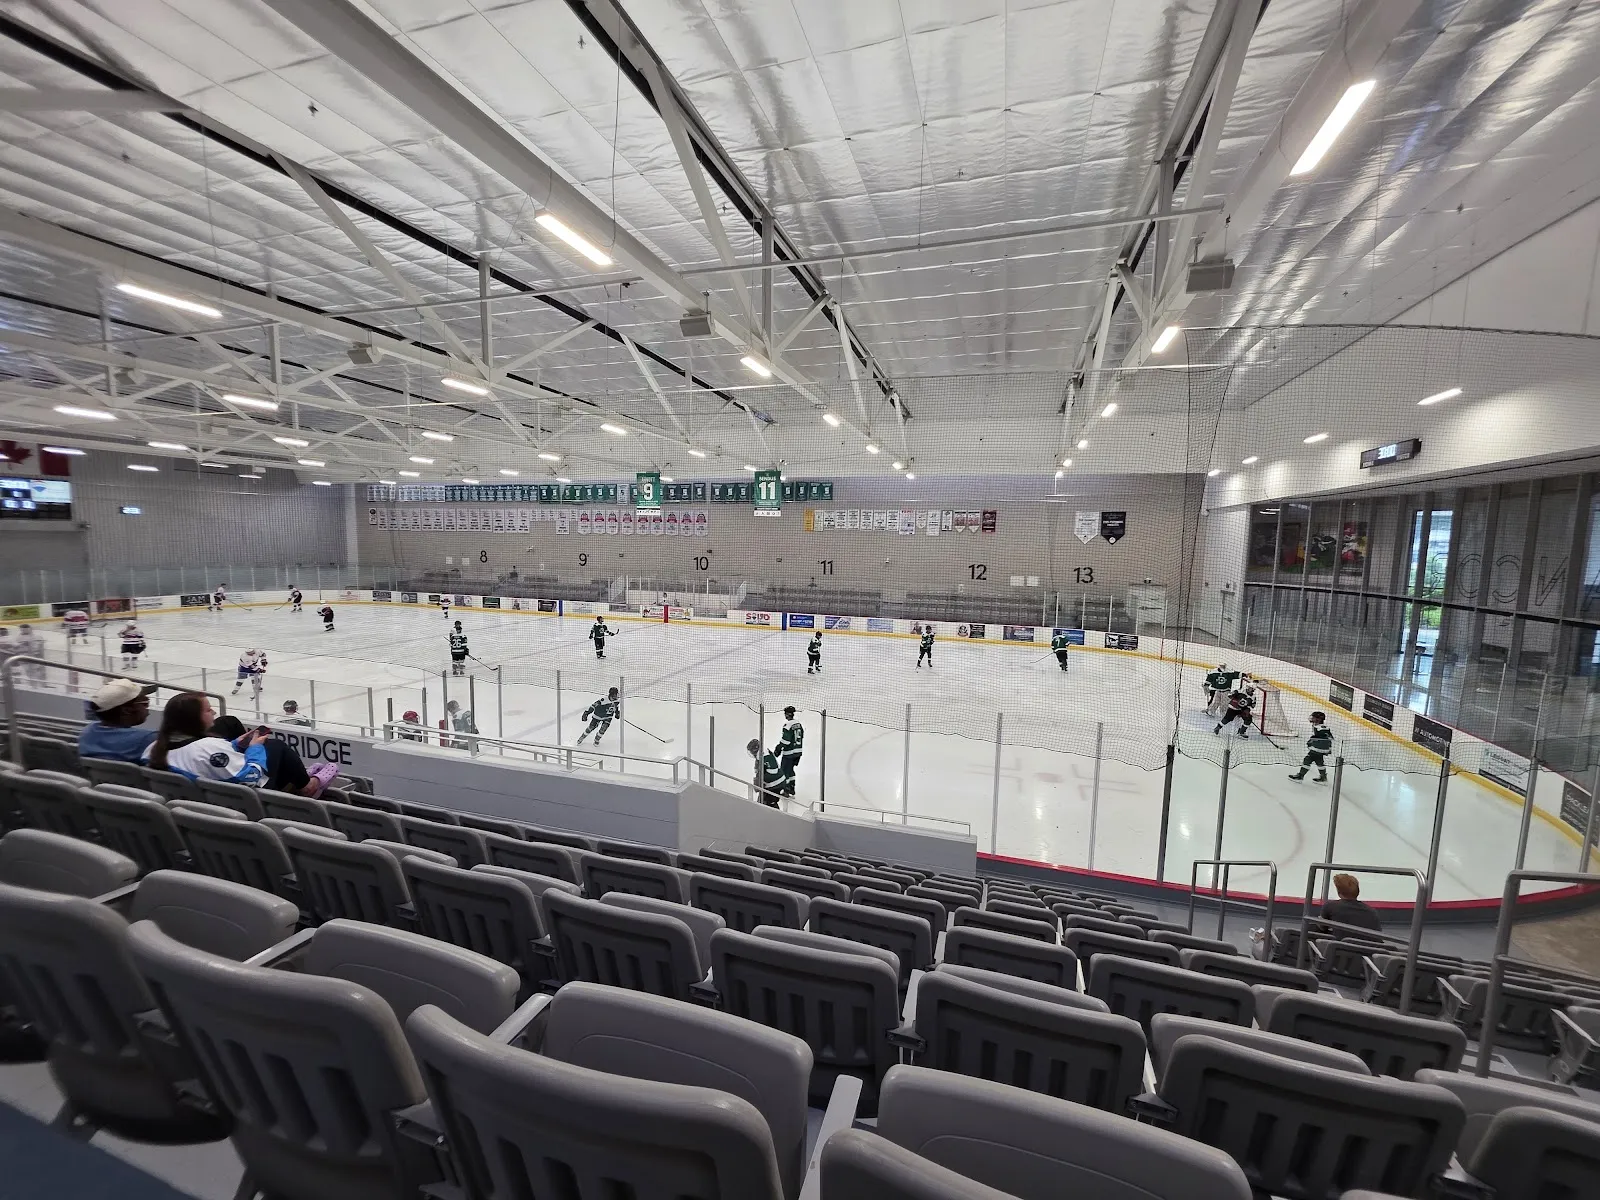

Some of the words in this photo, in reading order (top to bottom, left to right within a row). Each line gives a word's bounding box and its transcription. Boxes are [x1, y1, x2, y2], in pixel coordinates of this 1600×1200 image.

[643, 483, 653, 501] 9
[758, 481, 776, 500] 11
[479, 550, 488, 563] 8
[578, 553, 588, 566] 9
[693, 556, 709, 571] 10
[820, 560, 834, 575] 11
[968, 563, 987, 580] 12
[1073, 566, 1094, 584] 13
[452, 639, 462, 648] 26
